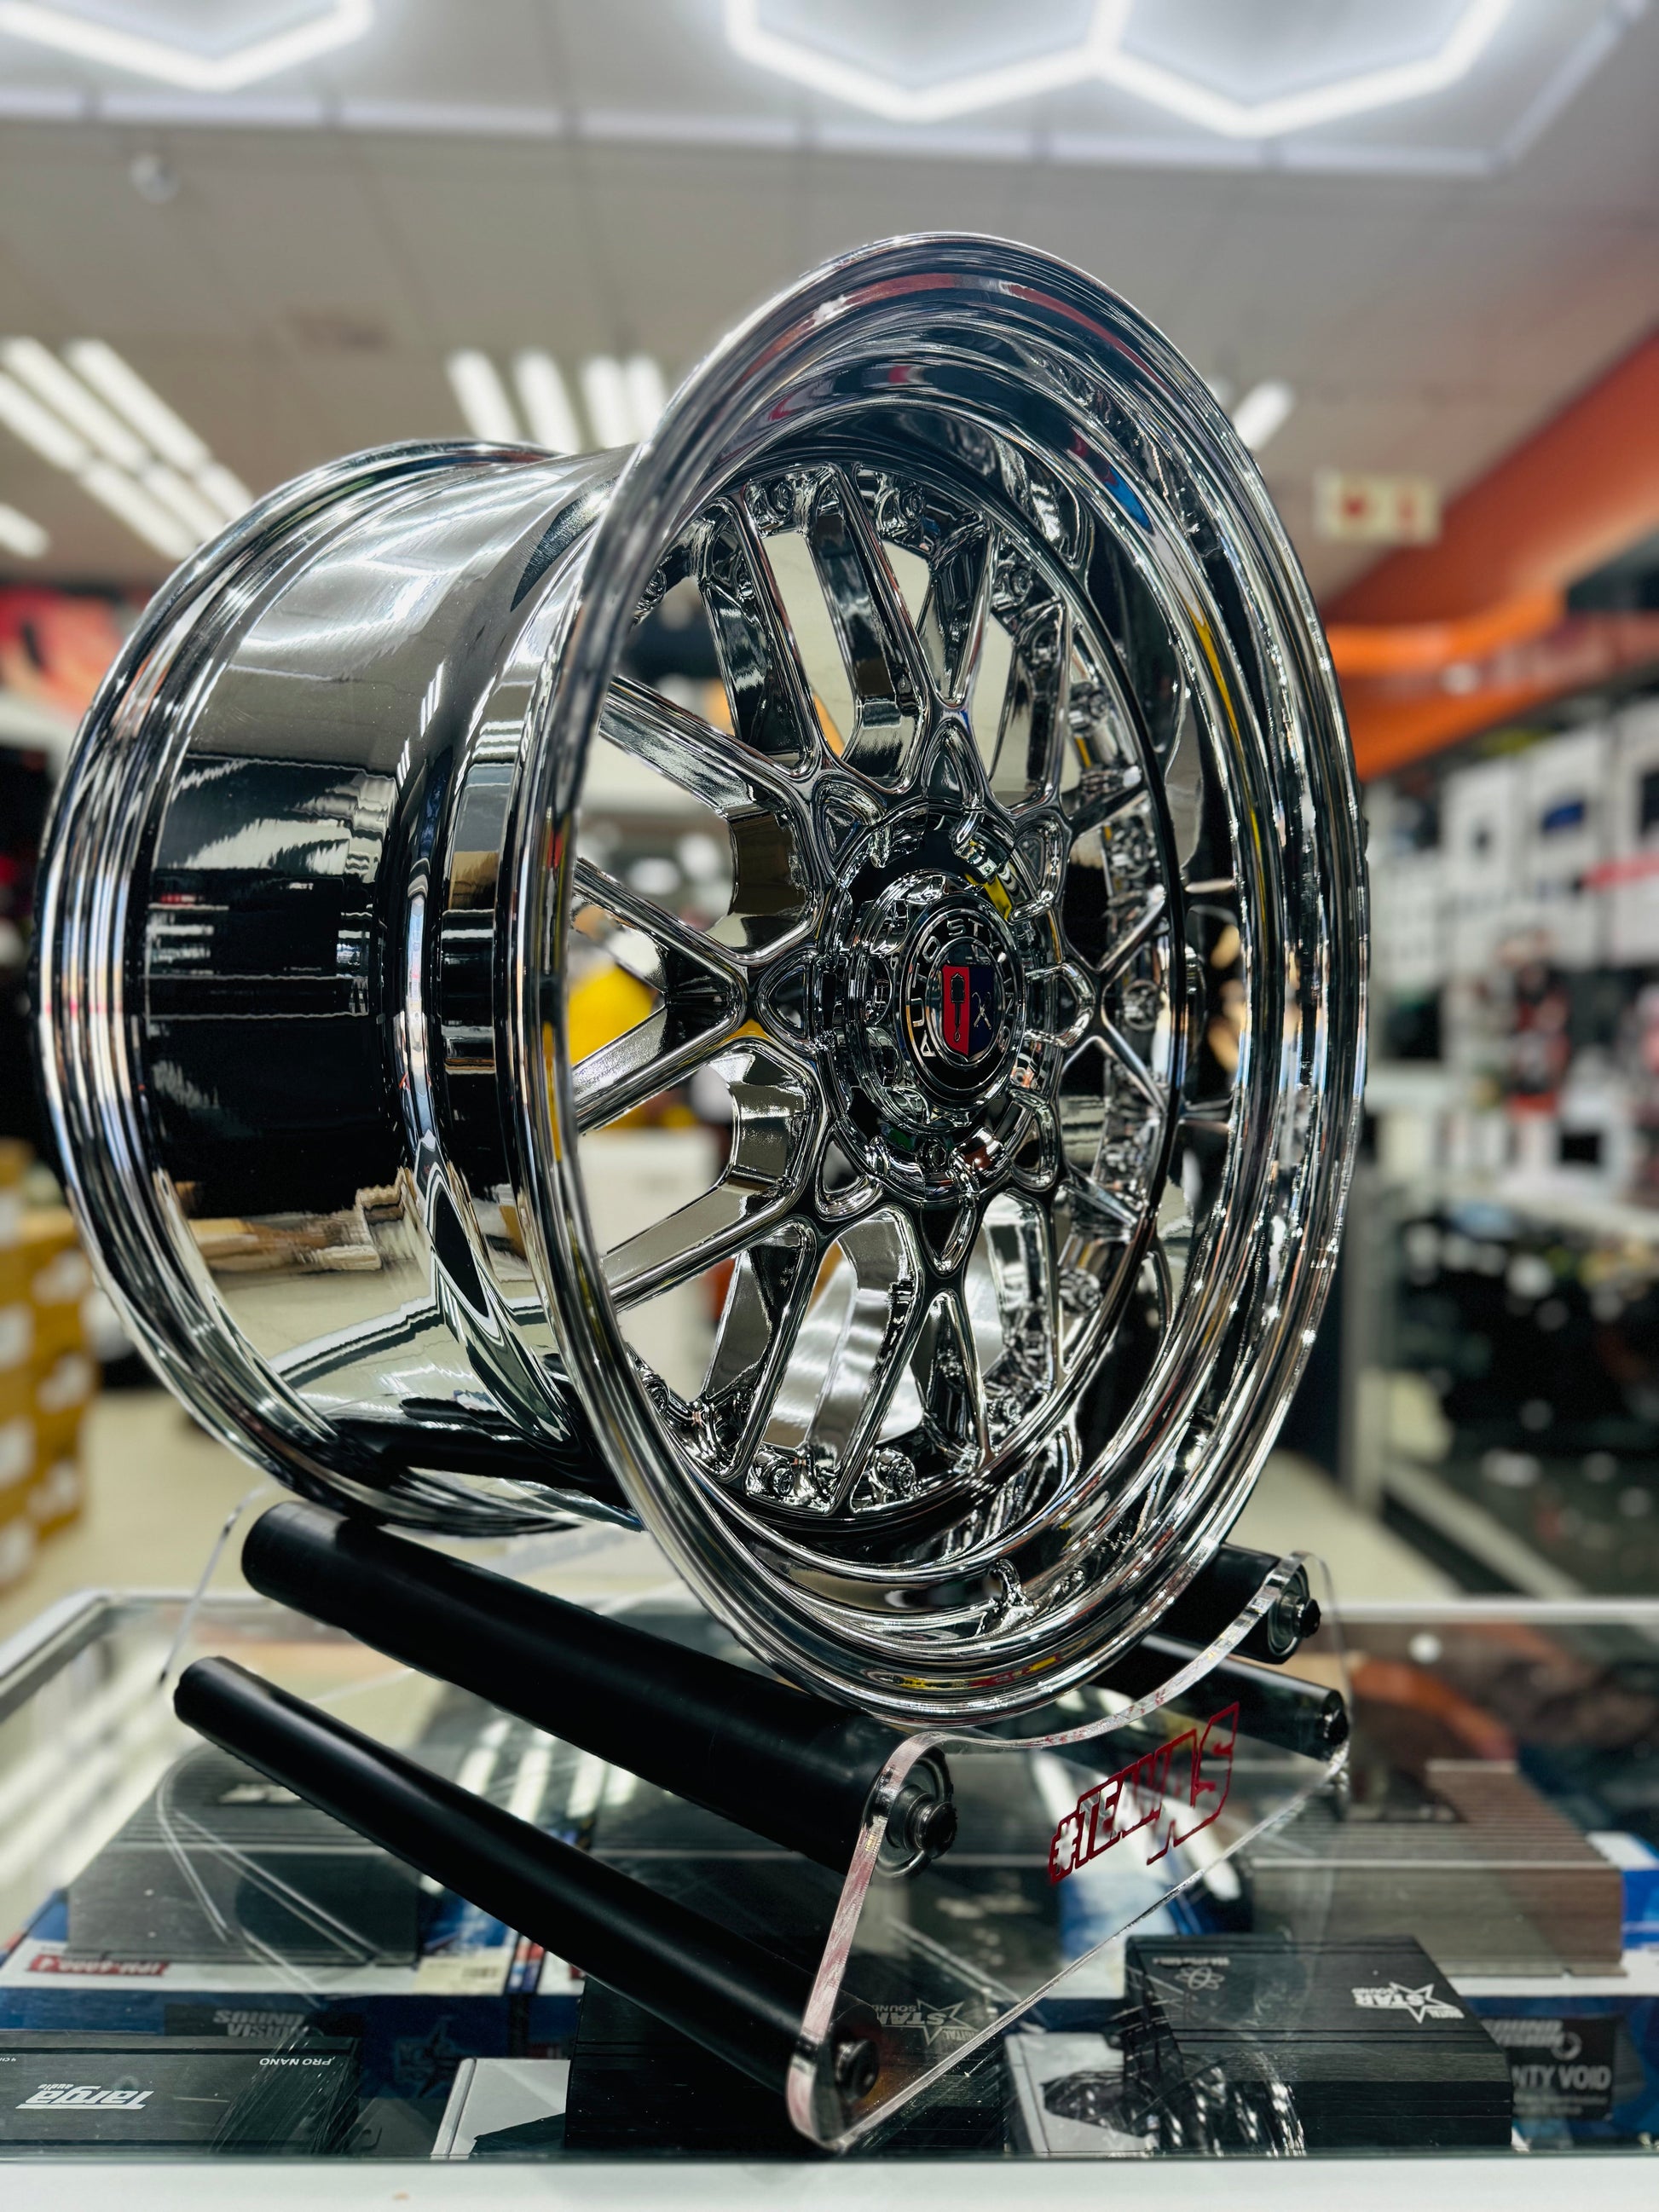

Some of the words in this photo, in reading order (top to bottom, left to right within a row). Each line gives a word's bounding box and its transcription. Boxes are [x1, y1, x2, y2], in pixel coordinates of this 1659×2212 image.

[1355, 1994, 1425, 2007] STAR
[212, 2009, 305, 2025] SOUND
[259, 2058, 300, 2066] NANO
[1558, 2065, 1613, 2091] VOID
[15, 2086, 155, 2110] Targa
